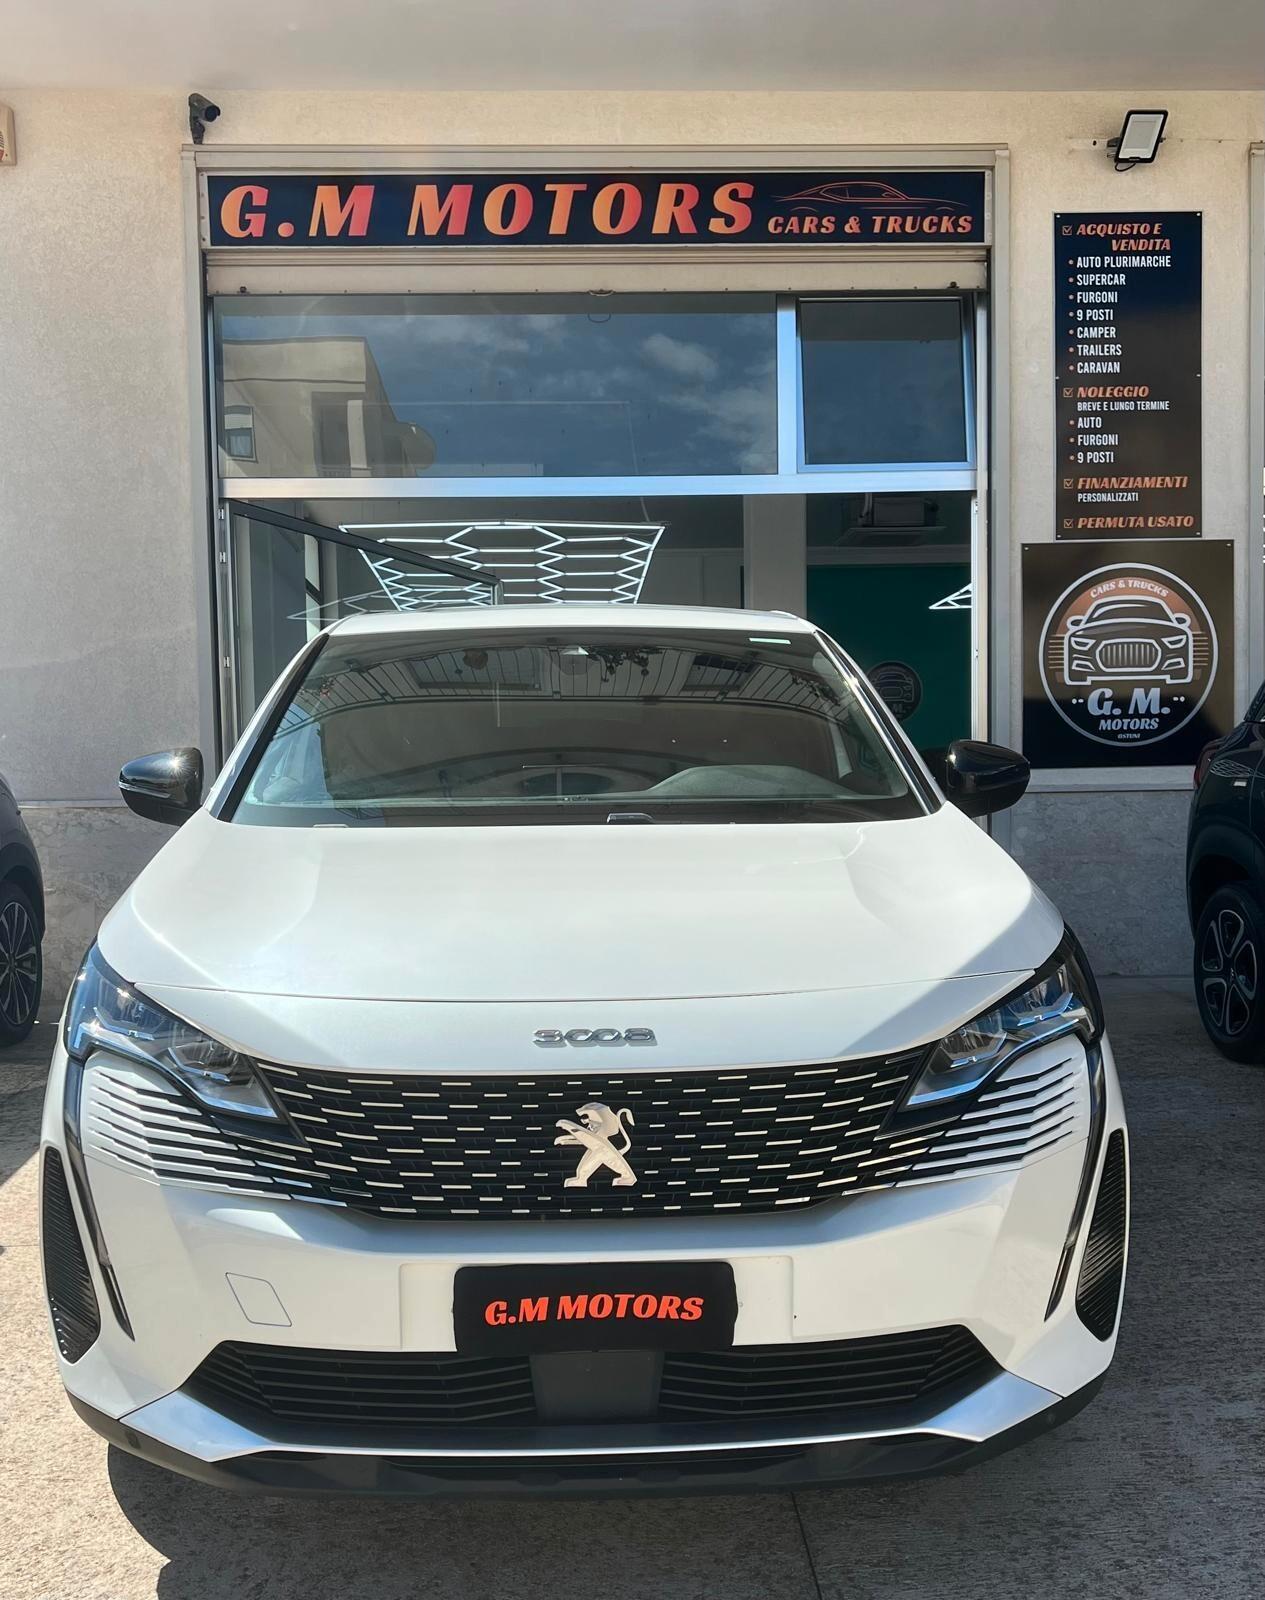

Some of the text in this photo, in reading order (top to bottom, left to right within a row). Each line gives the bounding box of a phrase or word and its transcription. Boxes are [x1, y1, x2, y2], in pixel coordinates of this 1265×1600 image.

[220, 183, 754, 238] G.M MOTORS
[768, 215, 973, 234] CARS & TRUCKS
[1077, 223, 1162, 237] ACQUISTO E
[1111, 239, 1171, 251] VENDITA
[1077, 256, 1171, 268] AUTO PLURIMARCHE
[1077, 274, 1125, 285] SUPERCAR
[1077, 292, 1117, 303] FURGONI
[1077, 310, 1113, 320] 9 POSTI
[1077, 327, 1116, 338] CAMPER
[1077, 344, 1122, 355] TRAILERS
[1077, 362, 1120, 373] CARAVAN
[1077, 386, 1149, 398] NOLEGGIO
[1078, 401, 1169, 411] BREVE E LUNGO TERMINE
[1078, 417, 1101, 428] AUTO
[1078, 434, 1118, 445] FURGONI
[1077, 452, 1114, 463] 9 POSTI
[1077, 477, 1188, 489] FINANZIAMENTI
[1078, 493, 1138, 502] PERSONALIZZATI
[1077, 516, 1194, 528] PERMUTA USATO
[1090, 581, 1116, 598] CARS
[1128, 580, 1169, 597] TRUCKS
[1099, 718, 1159, 731] MOTORS
[533, 1028, 657, 1048] 3008
[484, 1294, 704, 1326] G.M MOTORS
